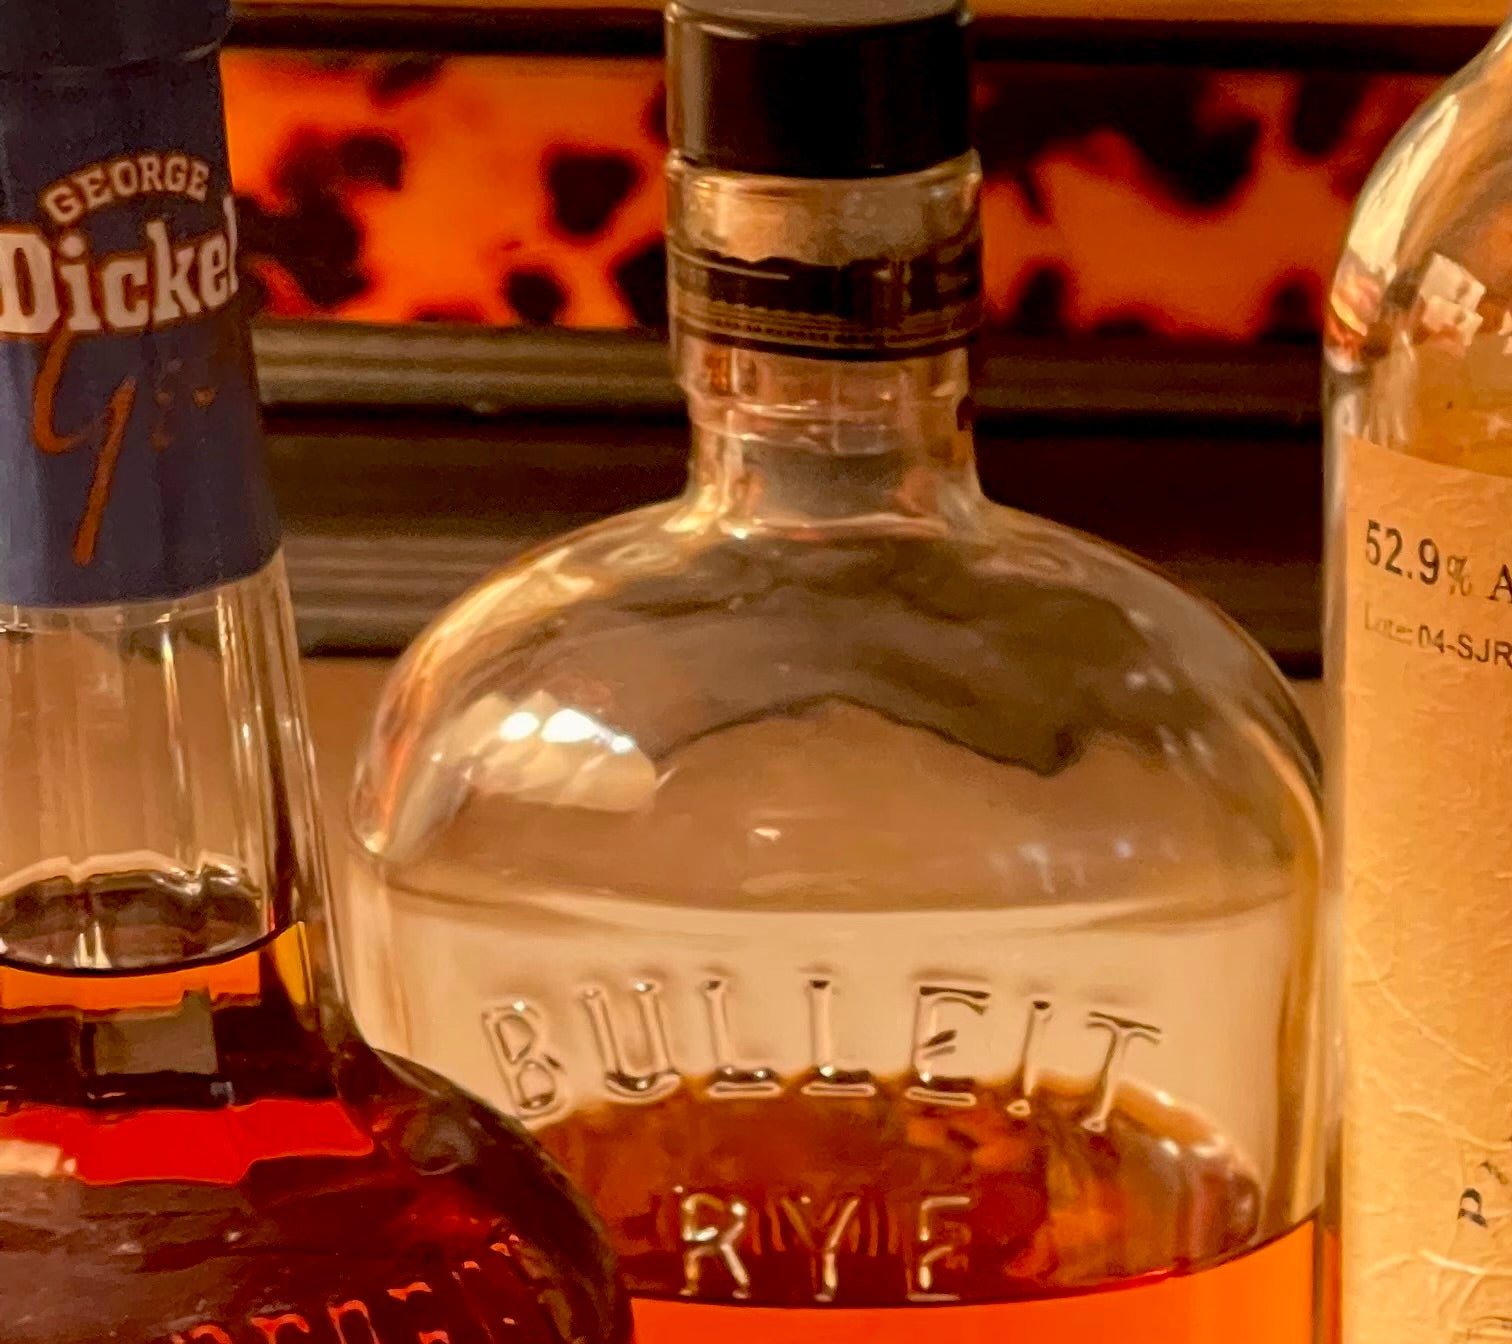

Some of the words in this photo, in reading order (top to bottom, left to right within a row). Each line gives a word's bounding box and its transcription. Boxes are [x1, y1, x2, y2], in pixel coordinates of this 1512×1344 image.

[43, 154, 211, 226] GEORGE
[0, 194, 240, 334] Dickel
[1364, 518, 1474, 598] 52.9%
[480, 976, 1166, 1132] BULLEIT
[674, 1188, 974, 1302] RYE
